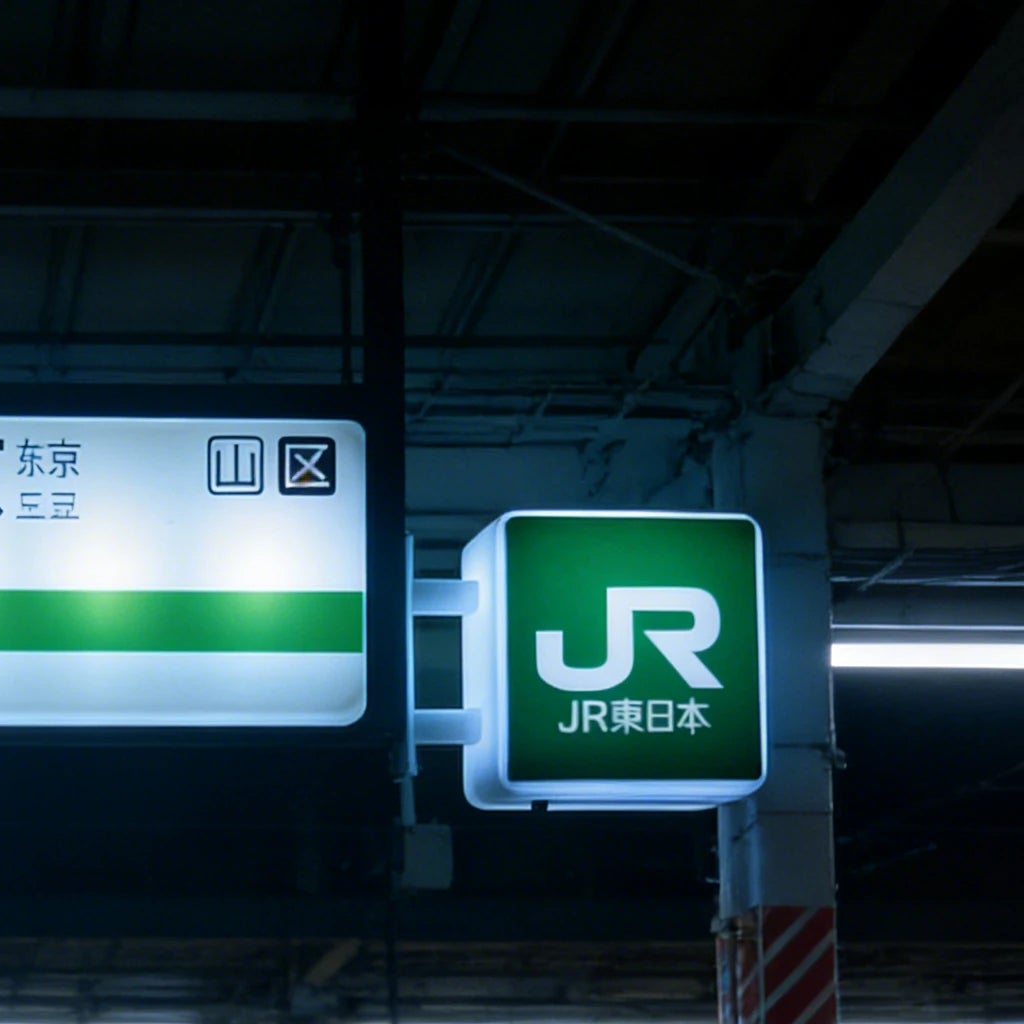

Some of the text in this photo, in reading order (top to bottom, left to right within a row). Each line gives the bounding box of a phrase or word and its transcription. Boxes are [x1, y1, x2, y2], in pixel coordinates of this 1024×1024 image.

[215, 442, 256, 491] 山
[535, 586, 724, 692] JR
[558, 697, 711, 735] JR東日本
